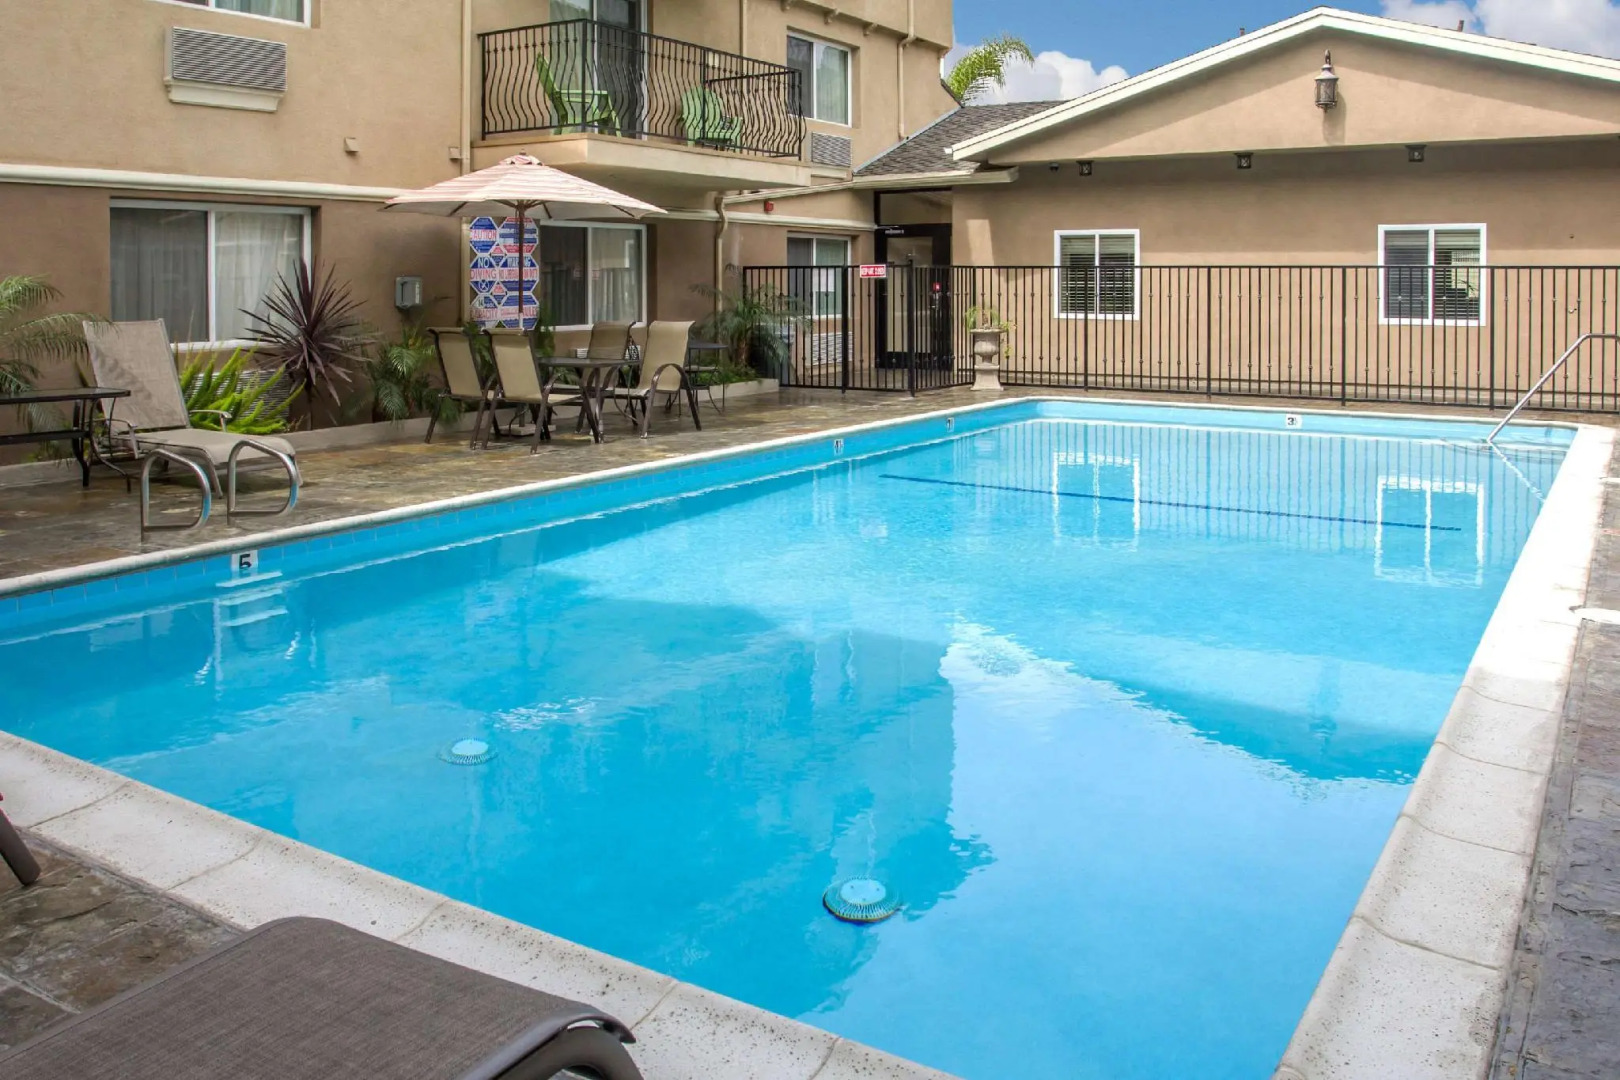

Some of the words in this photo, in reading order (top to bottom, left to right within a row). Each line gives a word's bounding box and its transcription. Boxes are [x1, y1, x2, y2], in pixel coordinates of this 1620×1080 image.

[478, 257, 489, 268] NO
[507, 257, 531, 268] WARNG
[470, 269, 496, 279] DIVING
[239, 553, 252, 569] 5
